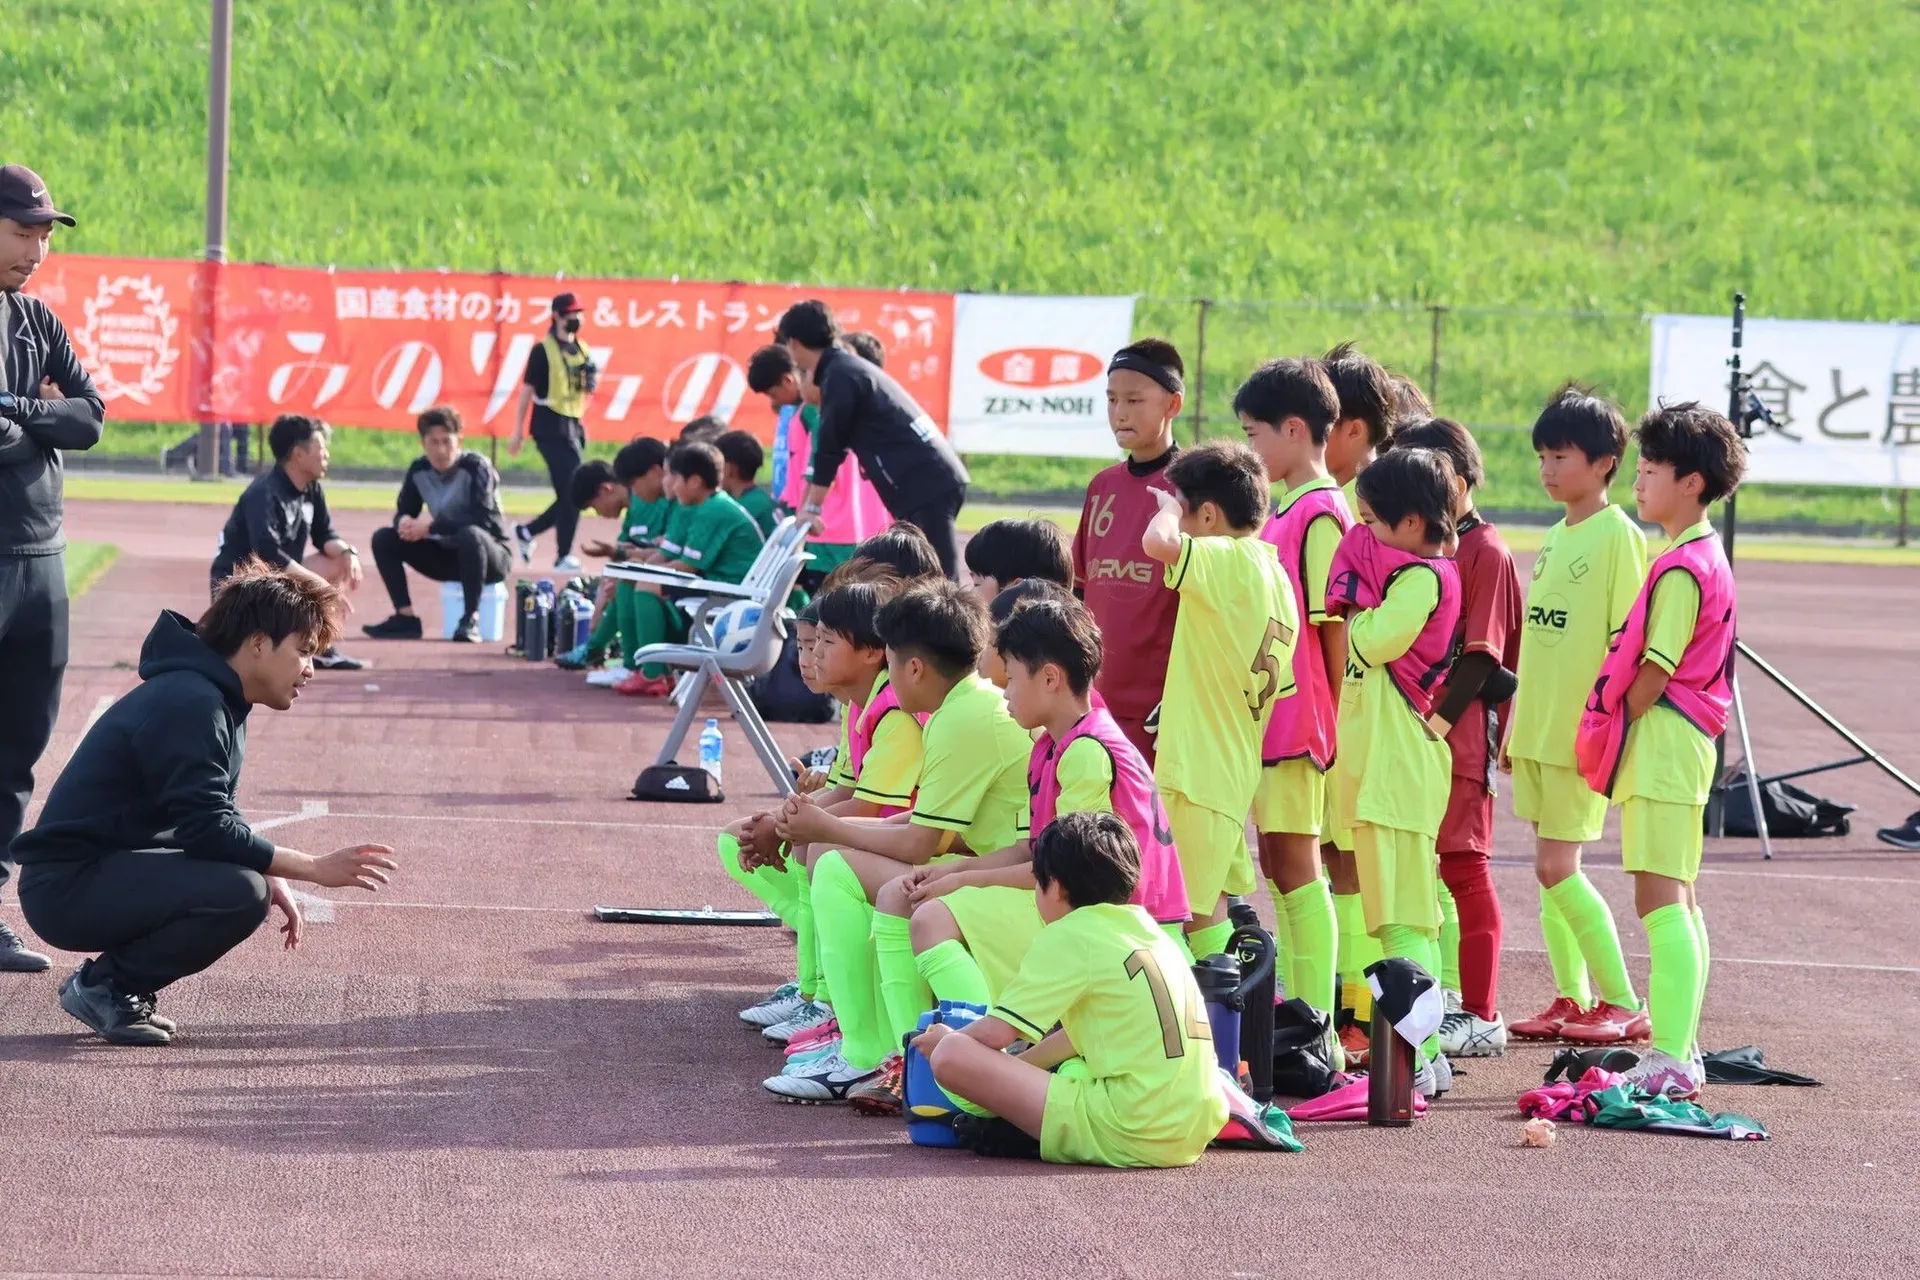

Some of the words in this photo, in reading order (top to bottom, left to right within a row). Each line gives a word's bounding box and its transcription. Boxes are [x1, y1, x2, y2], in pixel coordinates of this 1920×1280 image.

[335, 286, 784, 333] 国産食材のカフ&レストラン
[1088, 493, 1116, 539] 16
[1097, 558, 1154, 584] RMG
[1529, 606, 1568, 628] RMG
[1243, 616, 1294, 722] 5
